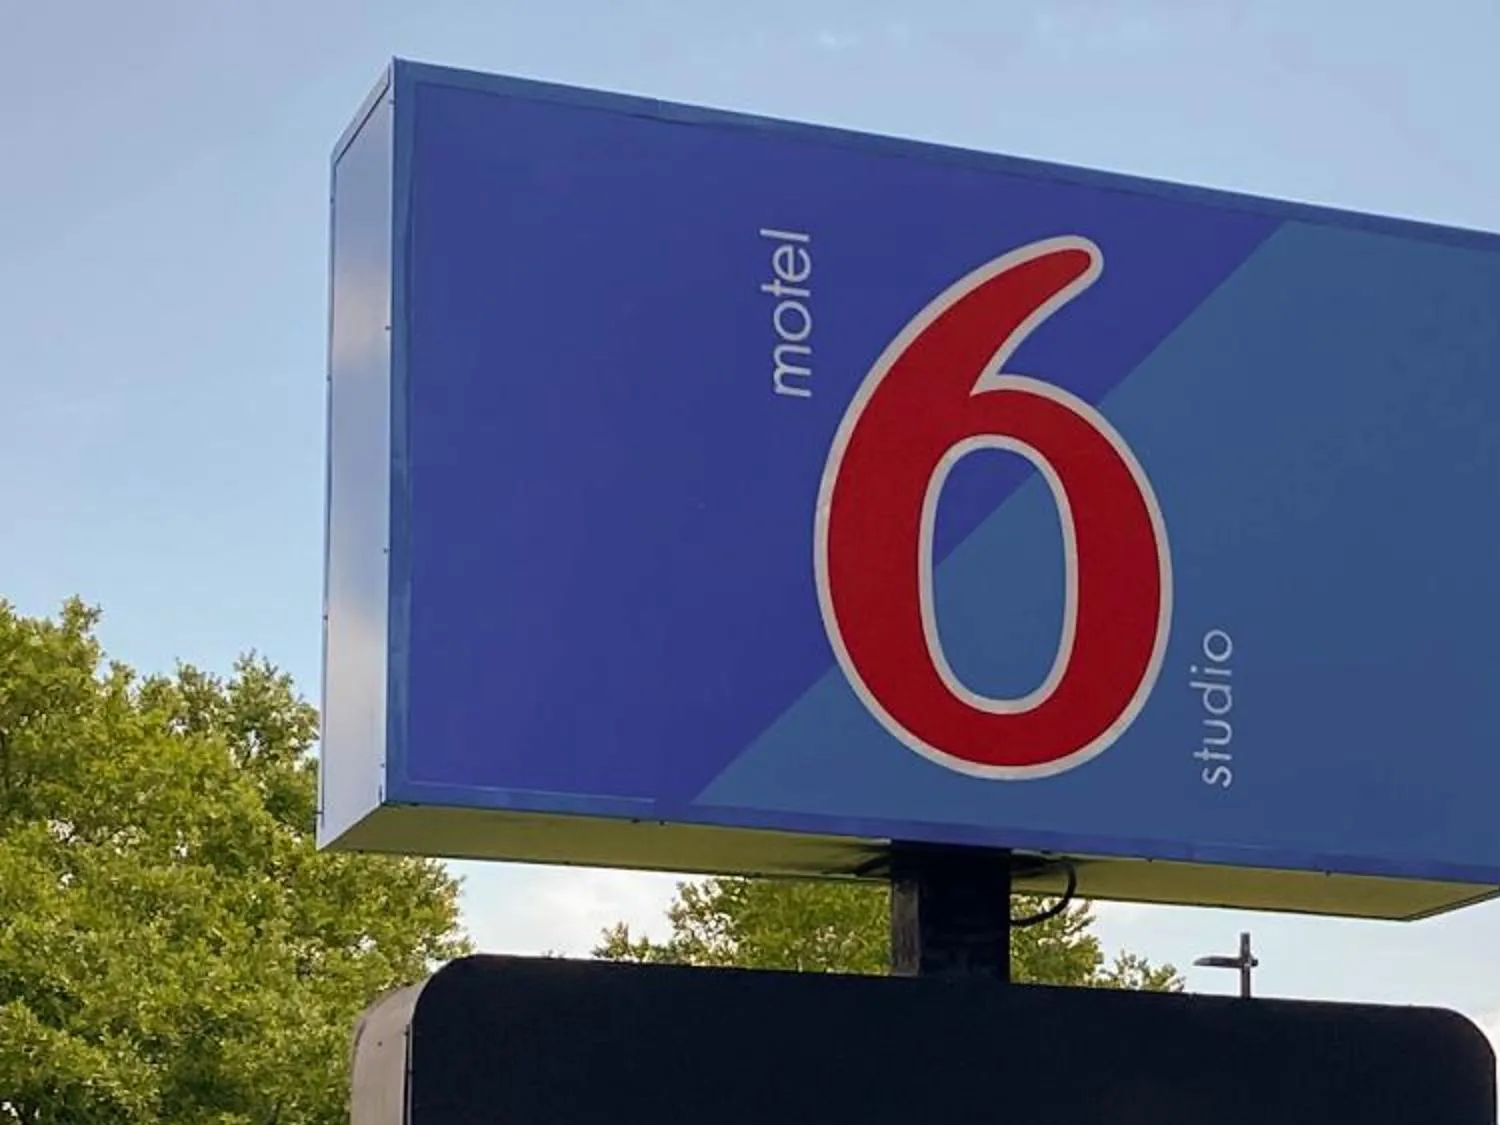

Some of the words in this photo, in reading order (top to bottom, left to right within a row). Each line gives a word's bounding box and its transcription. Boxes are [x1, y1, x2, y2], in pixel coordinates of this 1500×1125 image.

[760, 229, 812, 398] motel
[814, 235, 1173, 781] 6
[1190, 629, 1233, 788] studio
